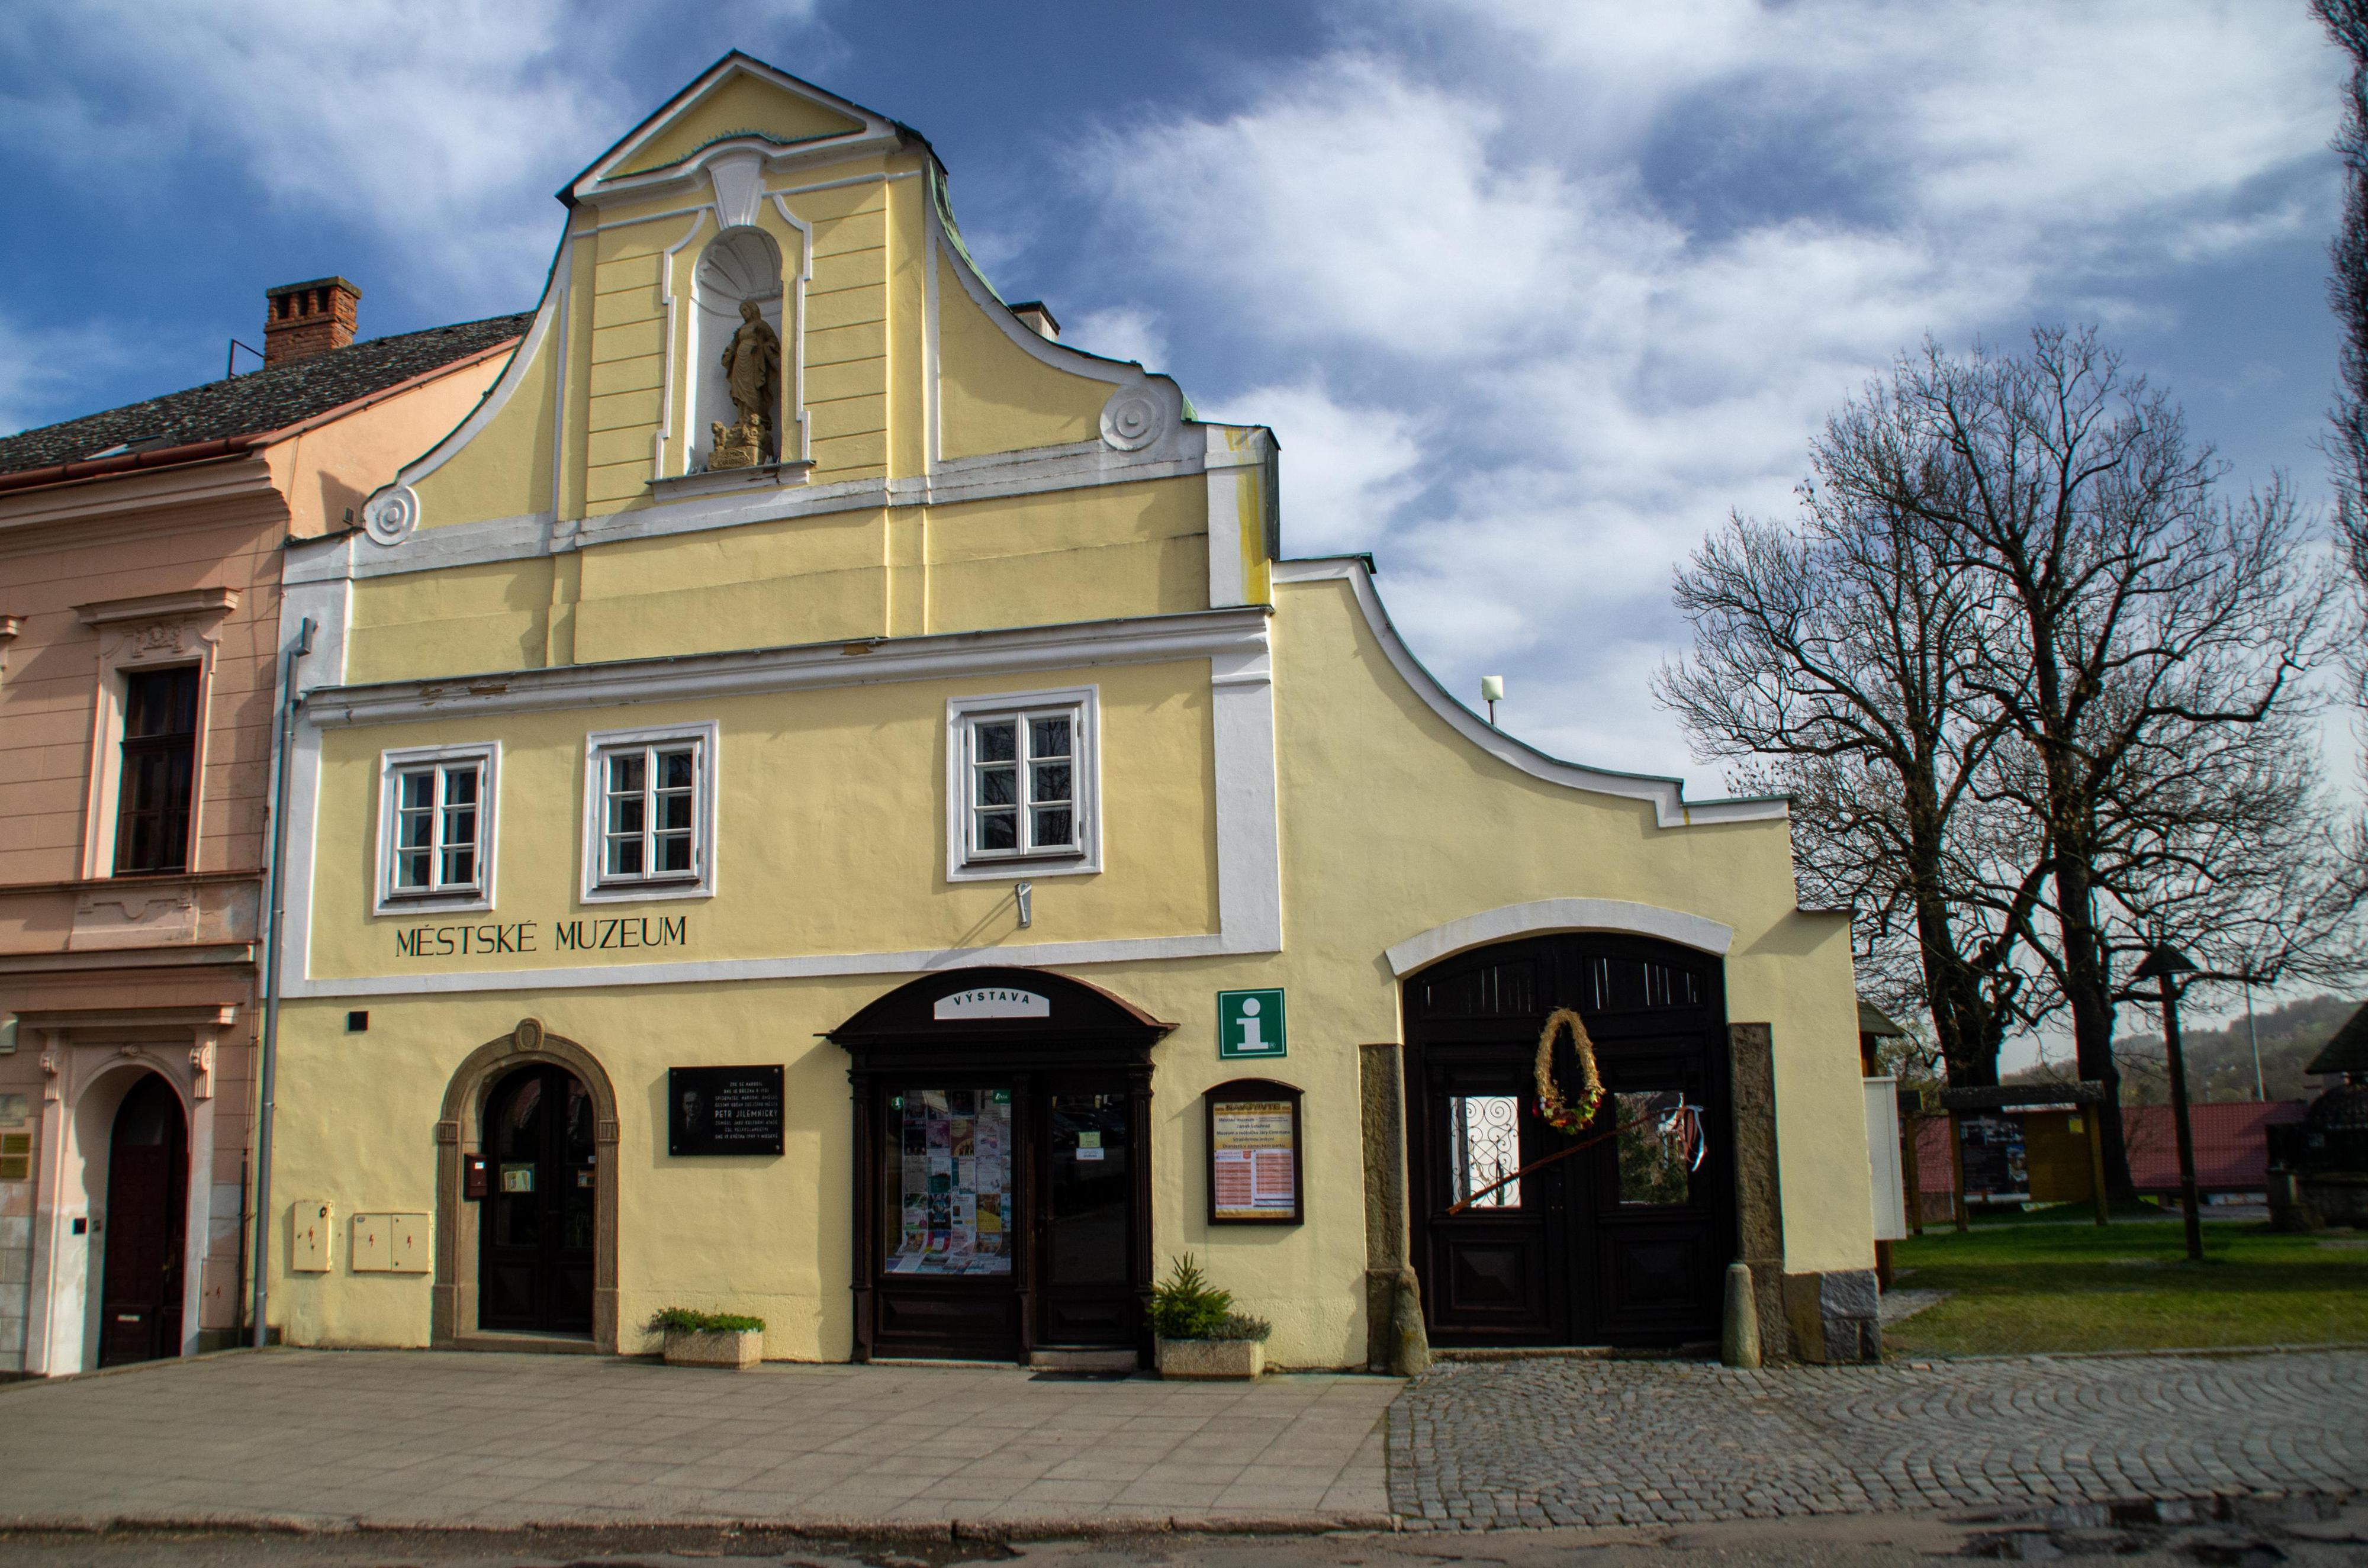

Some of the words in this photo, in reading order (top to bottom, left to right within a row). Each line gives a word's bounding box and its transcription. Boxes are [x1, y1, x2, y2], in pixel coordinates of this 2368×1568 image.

[395, 920, 537, 957] MĚSTSKÉ
[555, 916, 687, 951] MUZEUM
[954, 991, 1029, 1006] VÝSTAVA
[715, 1110, 732, 1118] PETR
